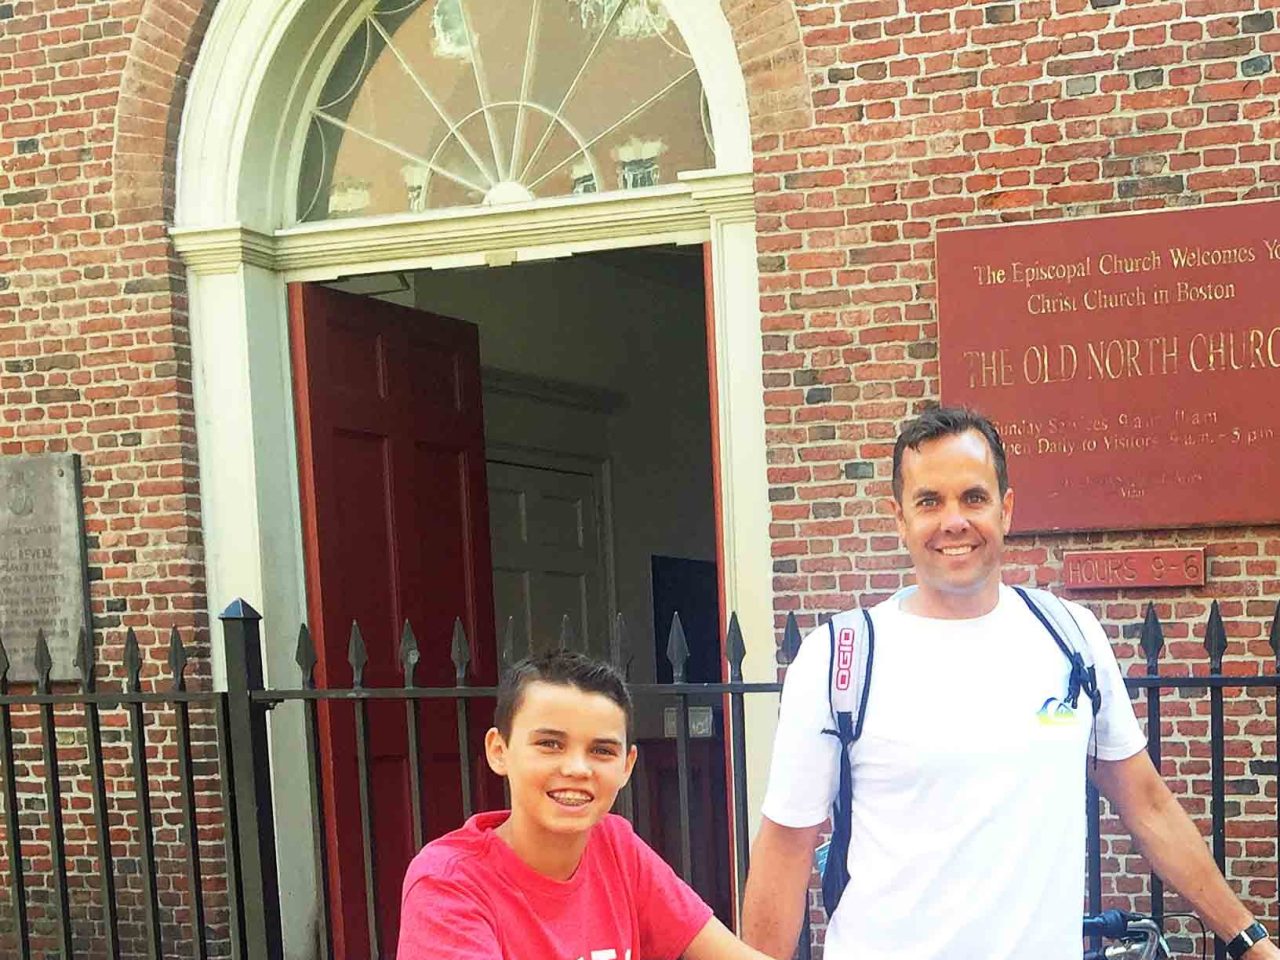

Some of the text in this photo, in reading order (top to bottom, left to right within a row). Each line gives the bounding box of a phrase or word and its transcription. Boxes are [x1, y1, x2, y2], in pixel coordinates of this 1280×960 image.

[974, 265, 1006, 286] The
[1012, 257, 1091, 287] Episcopal
[1099, 251, 1161, 275] Church
[1169, 246, 1256, 269] Welcomes
[1027, 281, 1236, 315] Christ Church in Boston
[963, 349, 1015, 388] THE
[1023, 343, 1077, 385] OLD
[1087, 334, 1179, 381] NORTH
[1069, 556, 1137, 584] HOURS
[836, 628, 855, 691] OGIO
